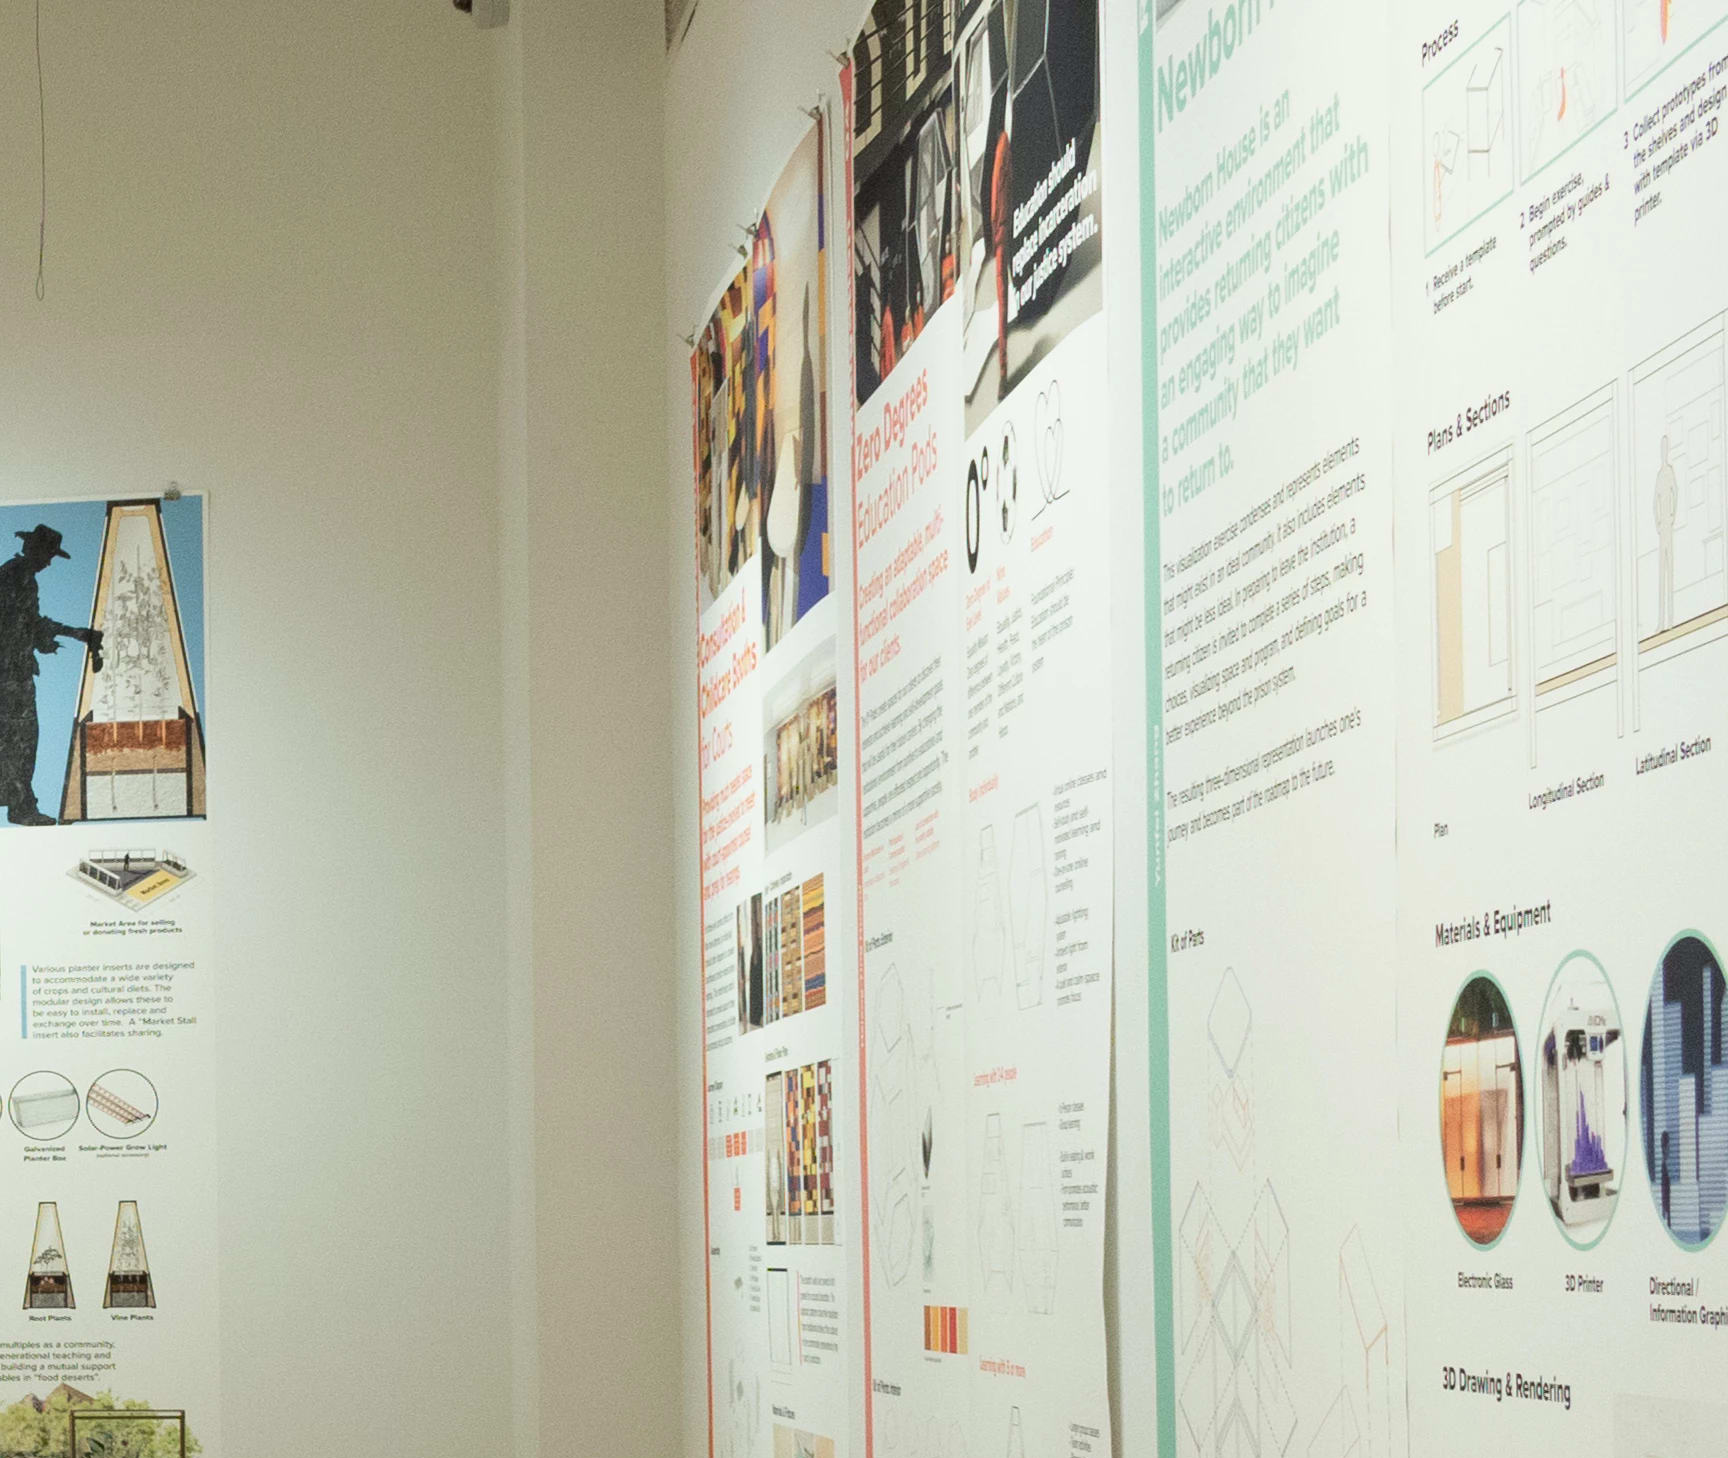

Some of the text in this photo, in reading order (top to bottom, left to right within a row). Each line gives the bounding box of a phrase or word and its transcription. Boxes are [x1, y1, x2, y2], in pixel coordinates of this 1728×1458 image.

[1422, 19, 1459, 67] Process
[856, 368, 928, 483] Zero Degrees
[1428, 391, 1510, 456] Plans & Sections
[857, 426, 937, 549] Education Pods
[1435, 900, 1551, 948] Materials & Equipment
[1458, 1272, 1513, 1290] Electronic Glass
[1565, 1275, 1604, 1293] 3D Printer
[1443, 1367, 1571, 1410] 3D Drawing & Rendering
